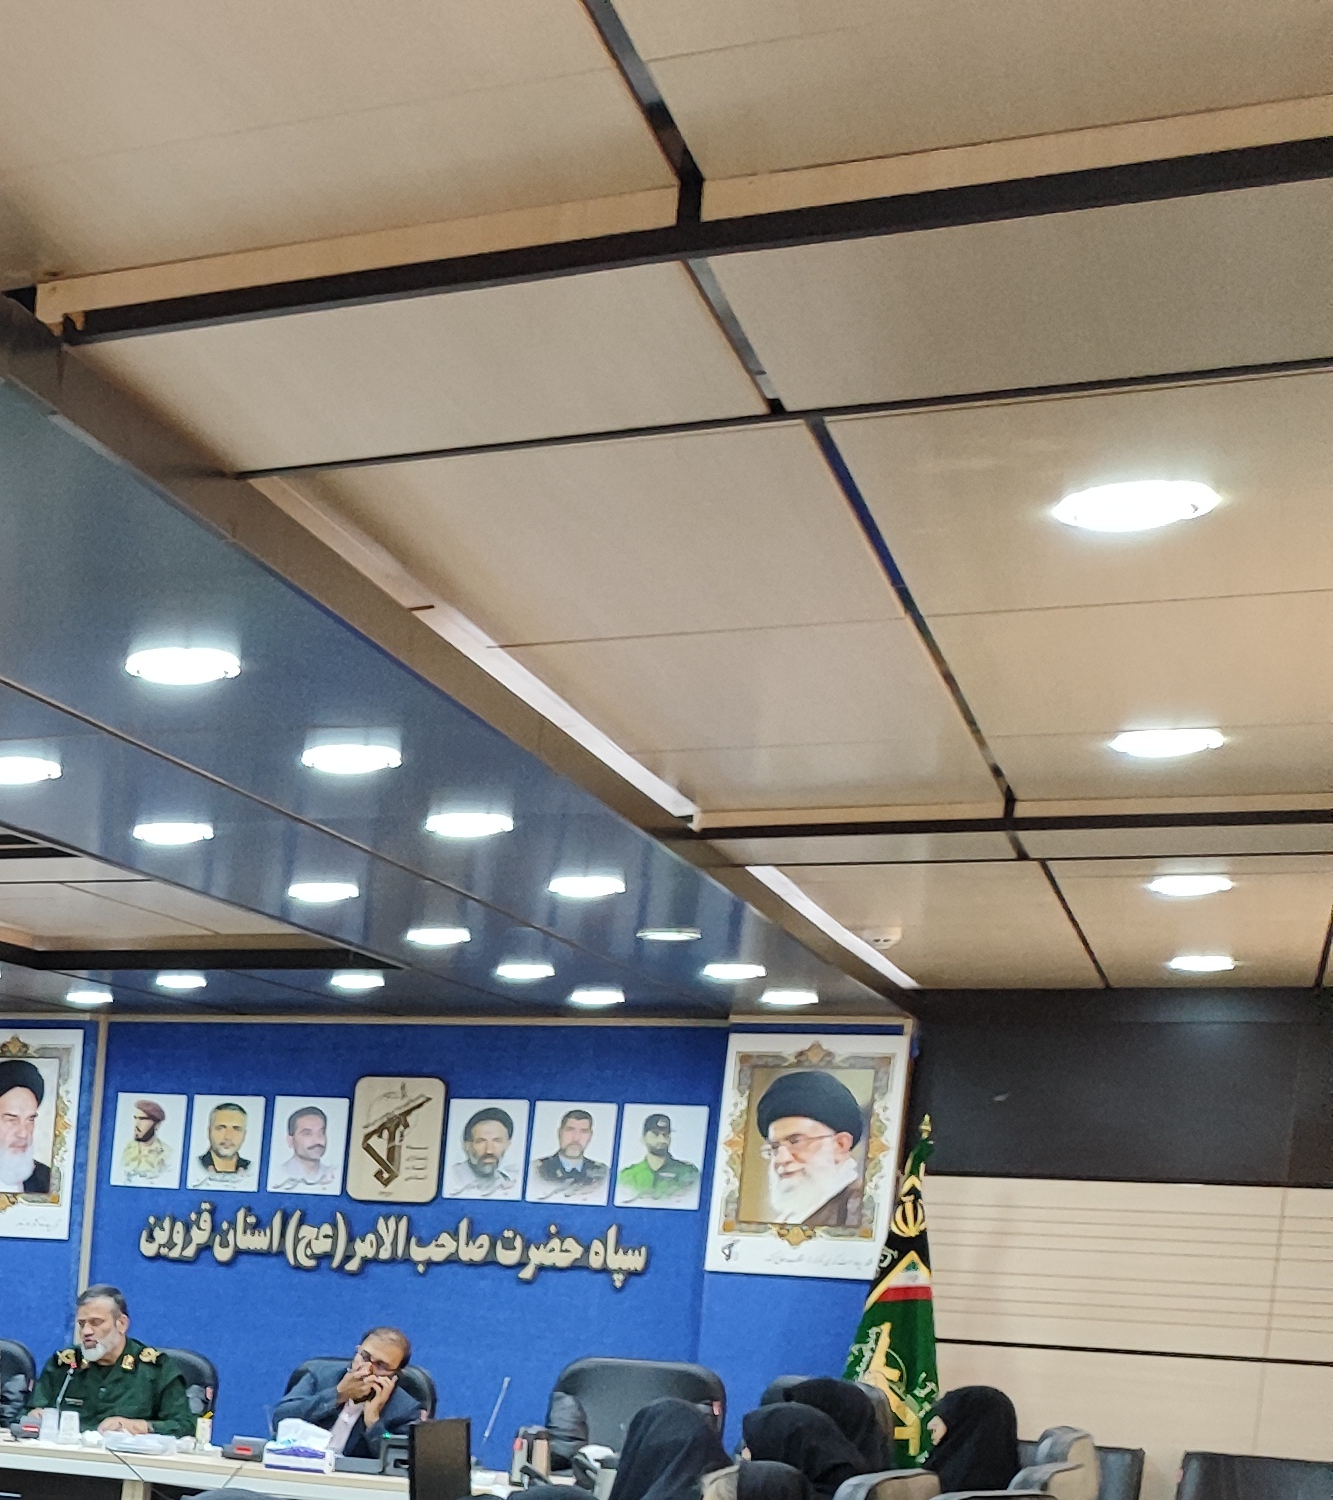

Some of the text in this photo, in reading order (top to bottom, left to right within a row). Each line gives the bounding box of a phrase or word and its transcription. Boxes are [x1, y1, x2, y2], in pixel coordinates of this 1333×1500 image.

[138, 1201, 212, 1260] قزوین
[212, 1206, 283, 1263] استان
[343, 1213, 409, 1274] الامر
[409, 1215, 491, 1275] صاحب
[495, 1223, 584, 1281] حضرت
[587, 1223, 647, 1290] سپاه
